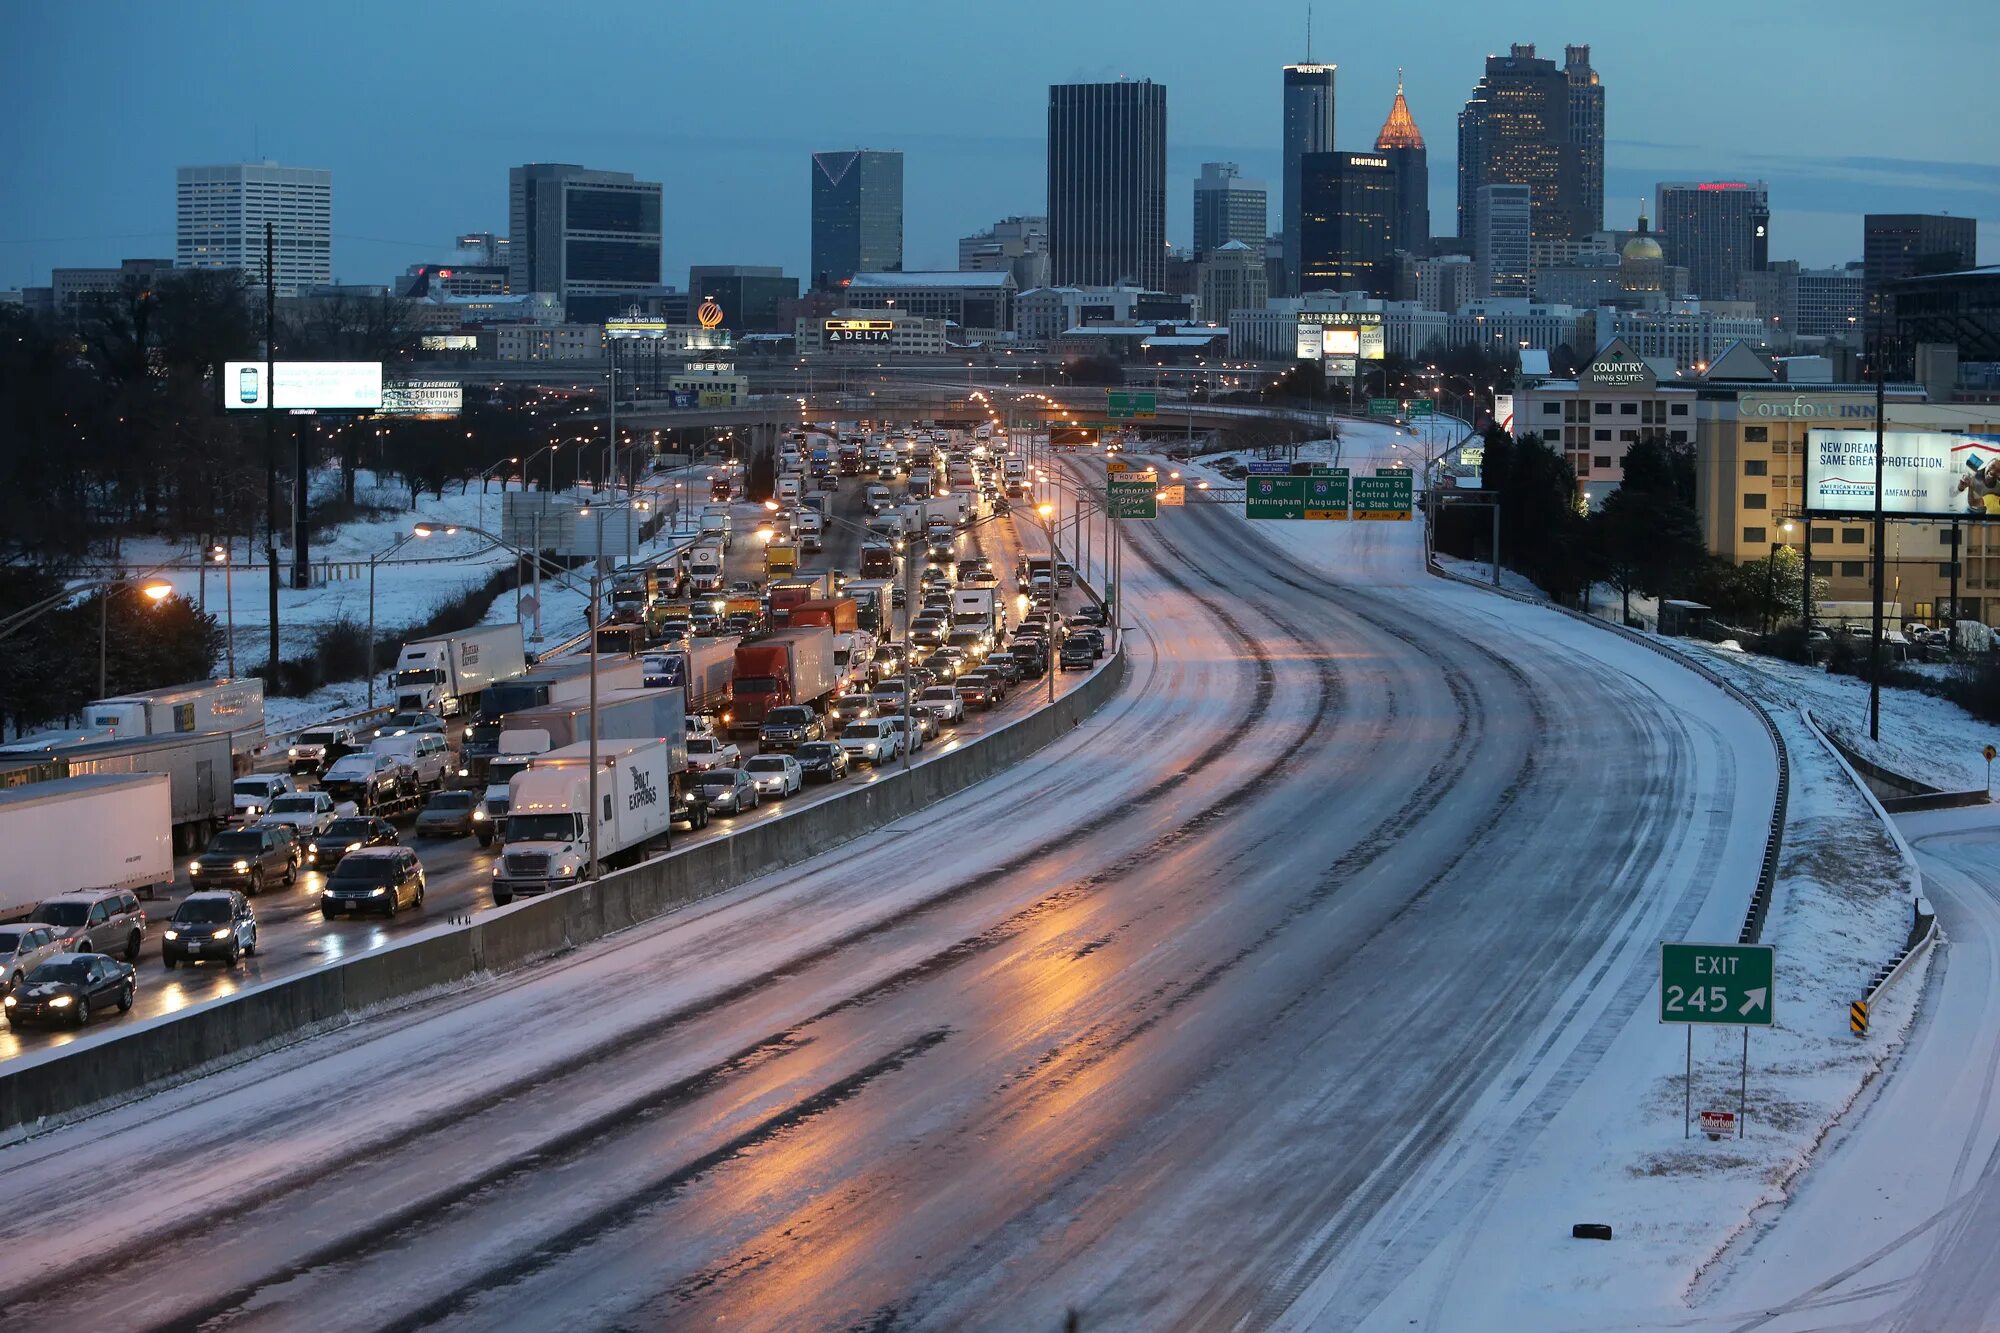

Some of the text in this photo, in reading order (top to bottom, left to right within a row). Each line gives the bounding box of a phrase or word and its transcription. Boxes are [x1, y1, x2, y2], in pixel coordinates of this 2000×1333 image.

[1296, 65, 1324, 74] WESTIN
[1351, 158, 1388, 167] EQUITABLE
[608, 317, 633, 325] Georgia
[845, 331, 889, 340] DELTA
[687, 363, 729, 371] IBEW
[1592, 362, 1644, 373] COUNTRY
[1593, 374, 1608, 382] INN
[1615, 374, 1644, 382] SUITES
[415, 390, 459, 399] SOLUTIONS
[1739, 394, 1877, 417] Comfort INN
[1820, 442, 1842, 453] NEW
[1820, 455, 1846, 466] SAME
[1882, 456, 1945, 469] PROTECTION.
[1261, 484, 1272, 492] 20
[1316, 484, 1327, 492] 20
[1361, 481, 1404, 489] Fulton St
[1884, 488, 1928, 498] AMFAM.COM
[1249, 497, 1302, 507] Birmingham
[1308, 499, 1346, 508] Augusta
[633, 770, 650, 791] BOLT
[629, 785, 657, 811] EXPRESS
[1694, 955, 1740, 975] EXIT
[1666, 985, 1728, 1013] 245
[1701, 1115, 1734, 1129] Robertson
